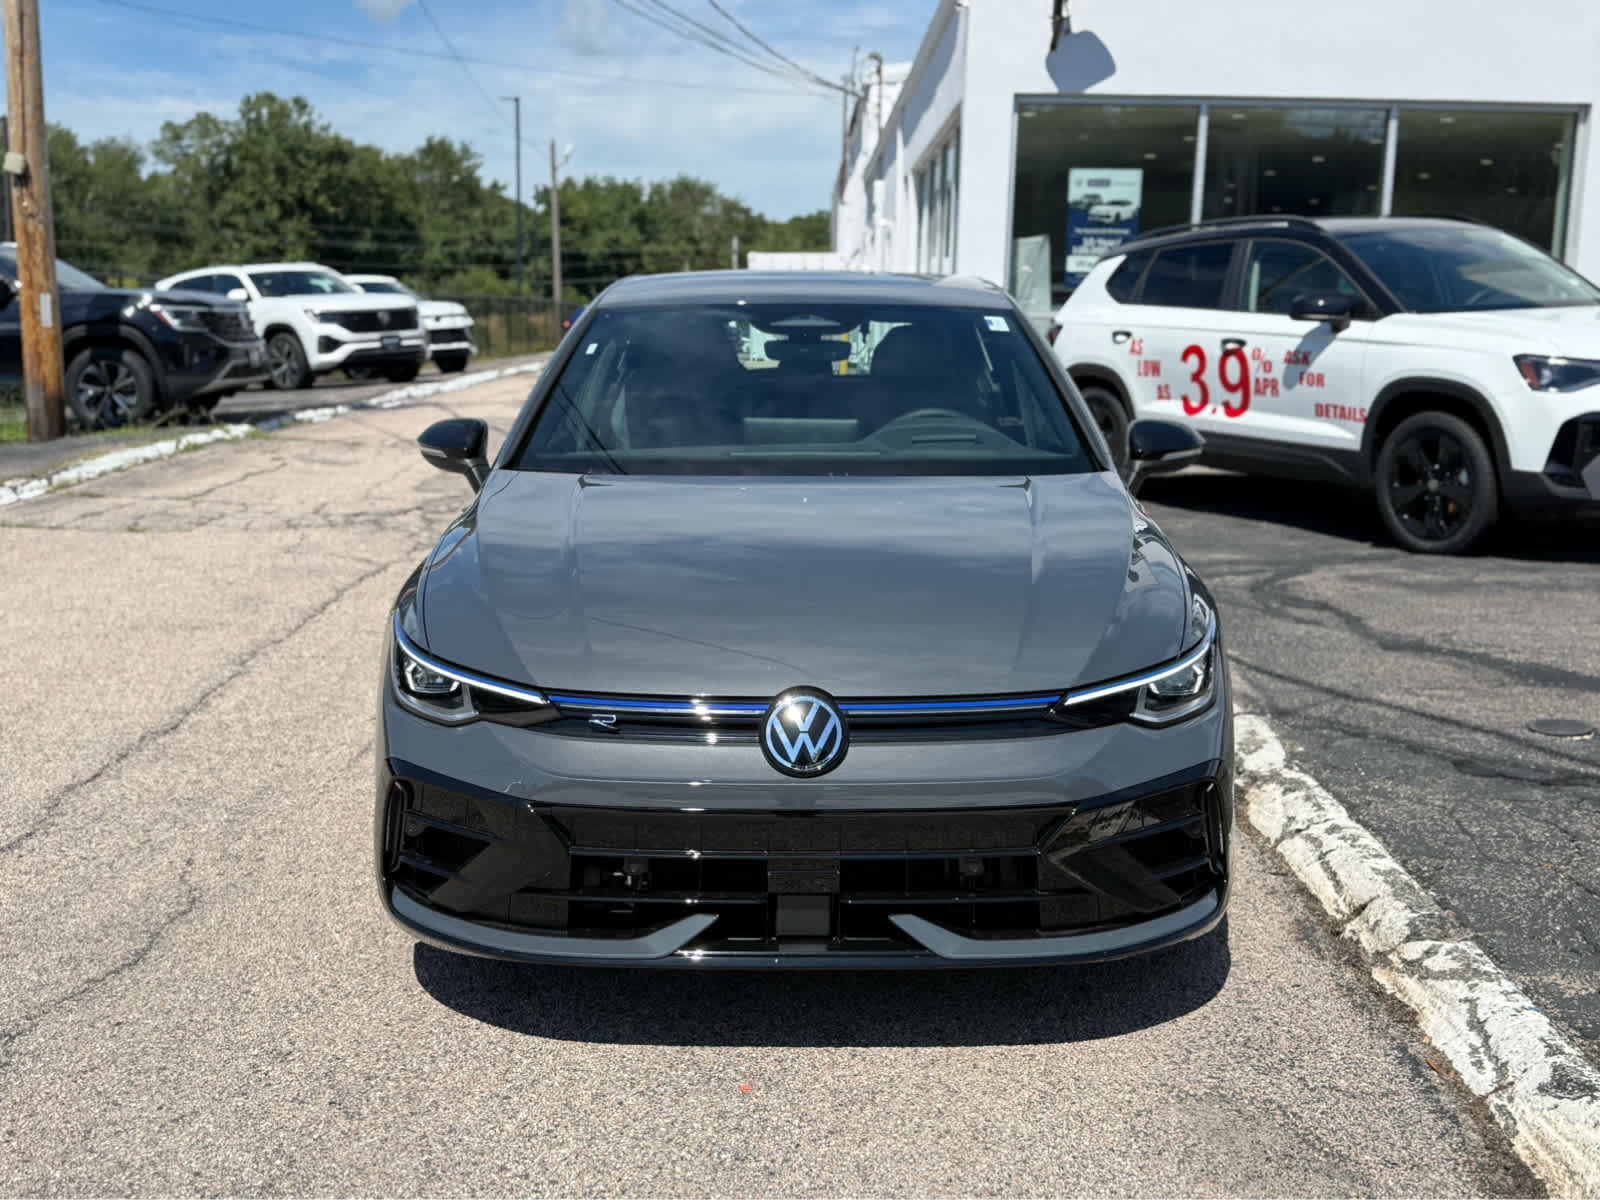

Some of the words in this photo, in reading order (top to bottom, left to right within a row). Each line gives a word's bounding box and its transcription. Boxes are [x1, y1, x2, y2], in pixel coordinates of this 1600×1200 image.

[1130, 338, 1144, 355] AS
[1284, 351, 1311, 365] ASK
[1138, 360, 1161, 377] LOW
[1254, 378, 1280, 398] APR
[1299, 372, 1325, 388] FOR
[1157, 384, 1171, 400] AS
[1314, 403, 1367, 423] DETAILS
